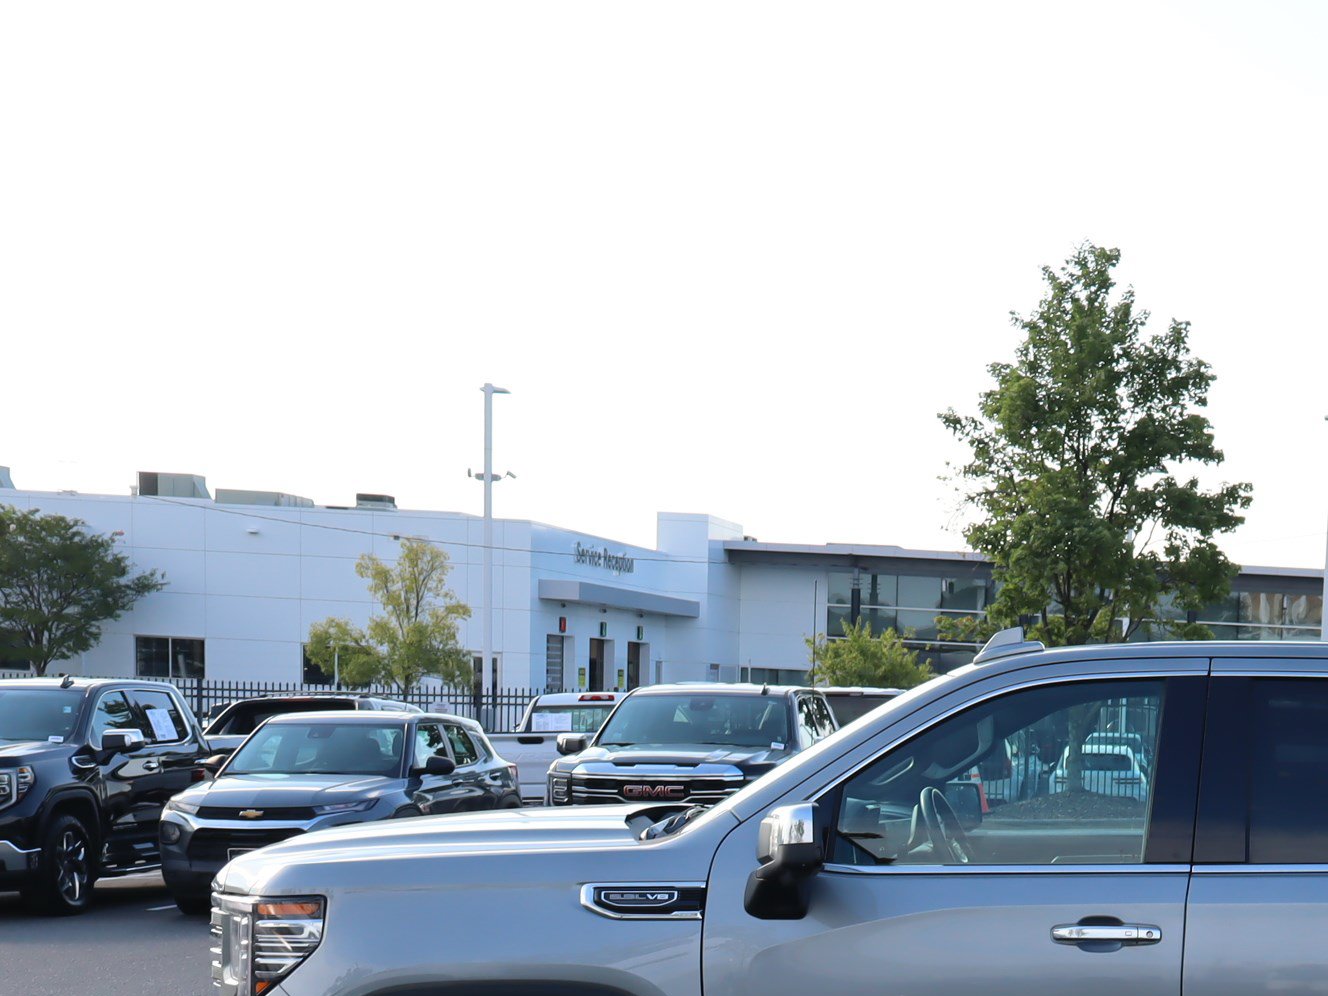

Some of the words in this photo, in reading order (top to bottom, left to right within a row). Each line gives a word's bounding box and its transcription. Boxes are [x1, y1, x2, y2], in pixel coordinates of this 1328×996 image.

[575, 541, 602, 567] Service
[603, 547, 635, 576] Reception
[623, 784, 685, 798] GMC
